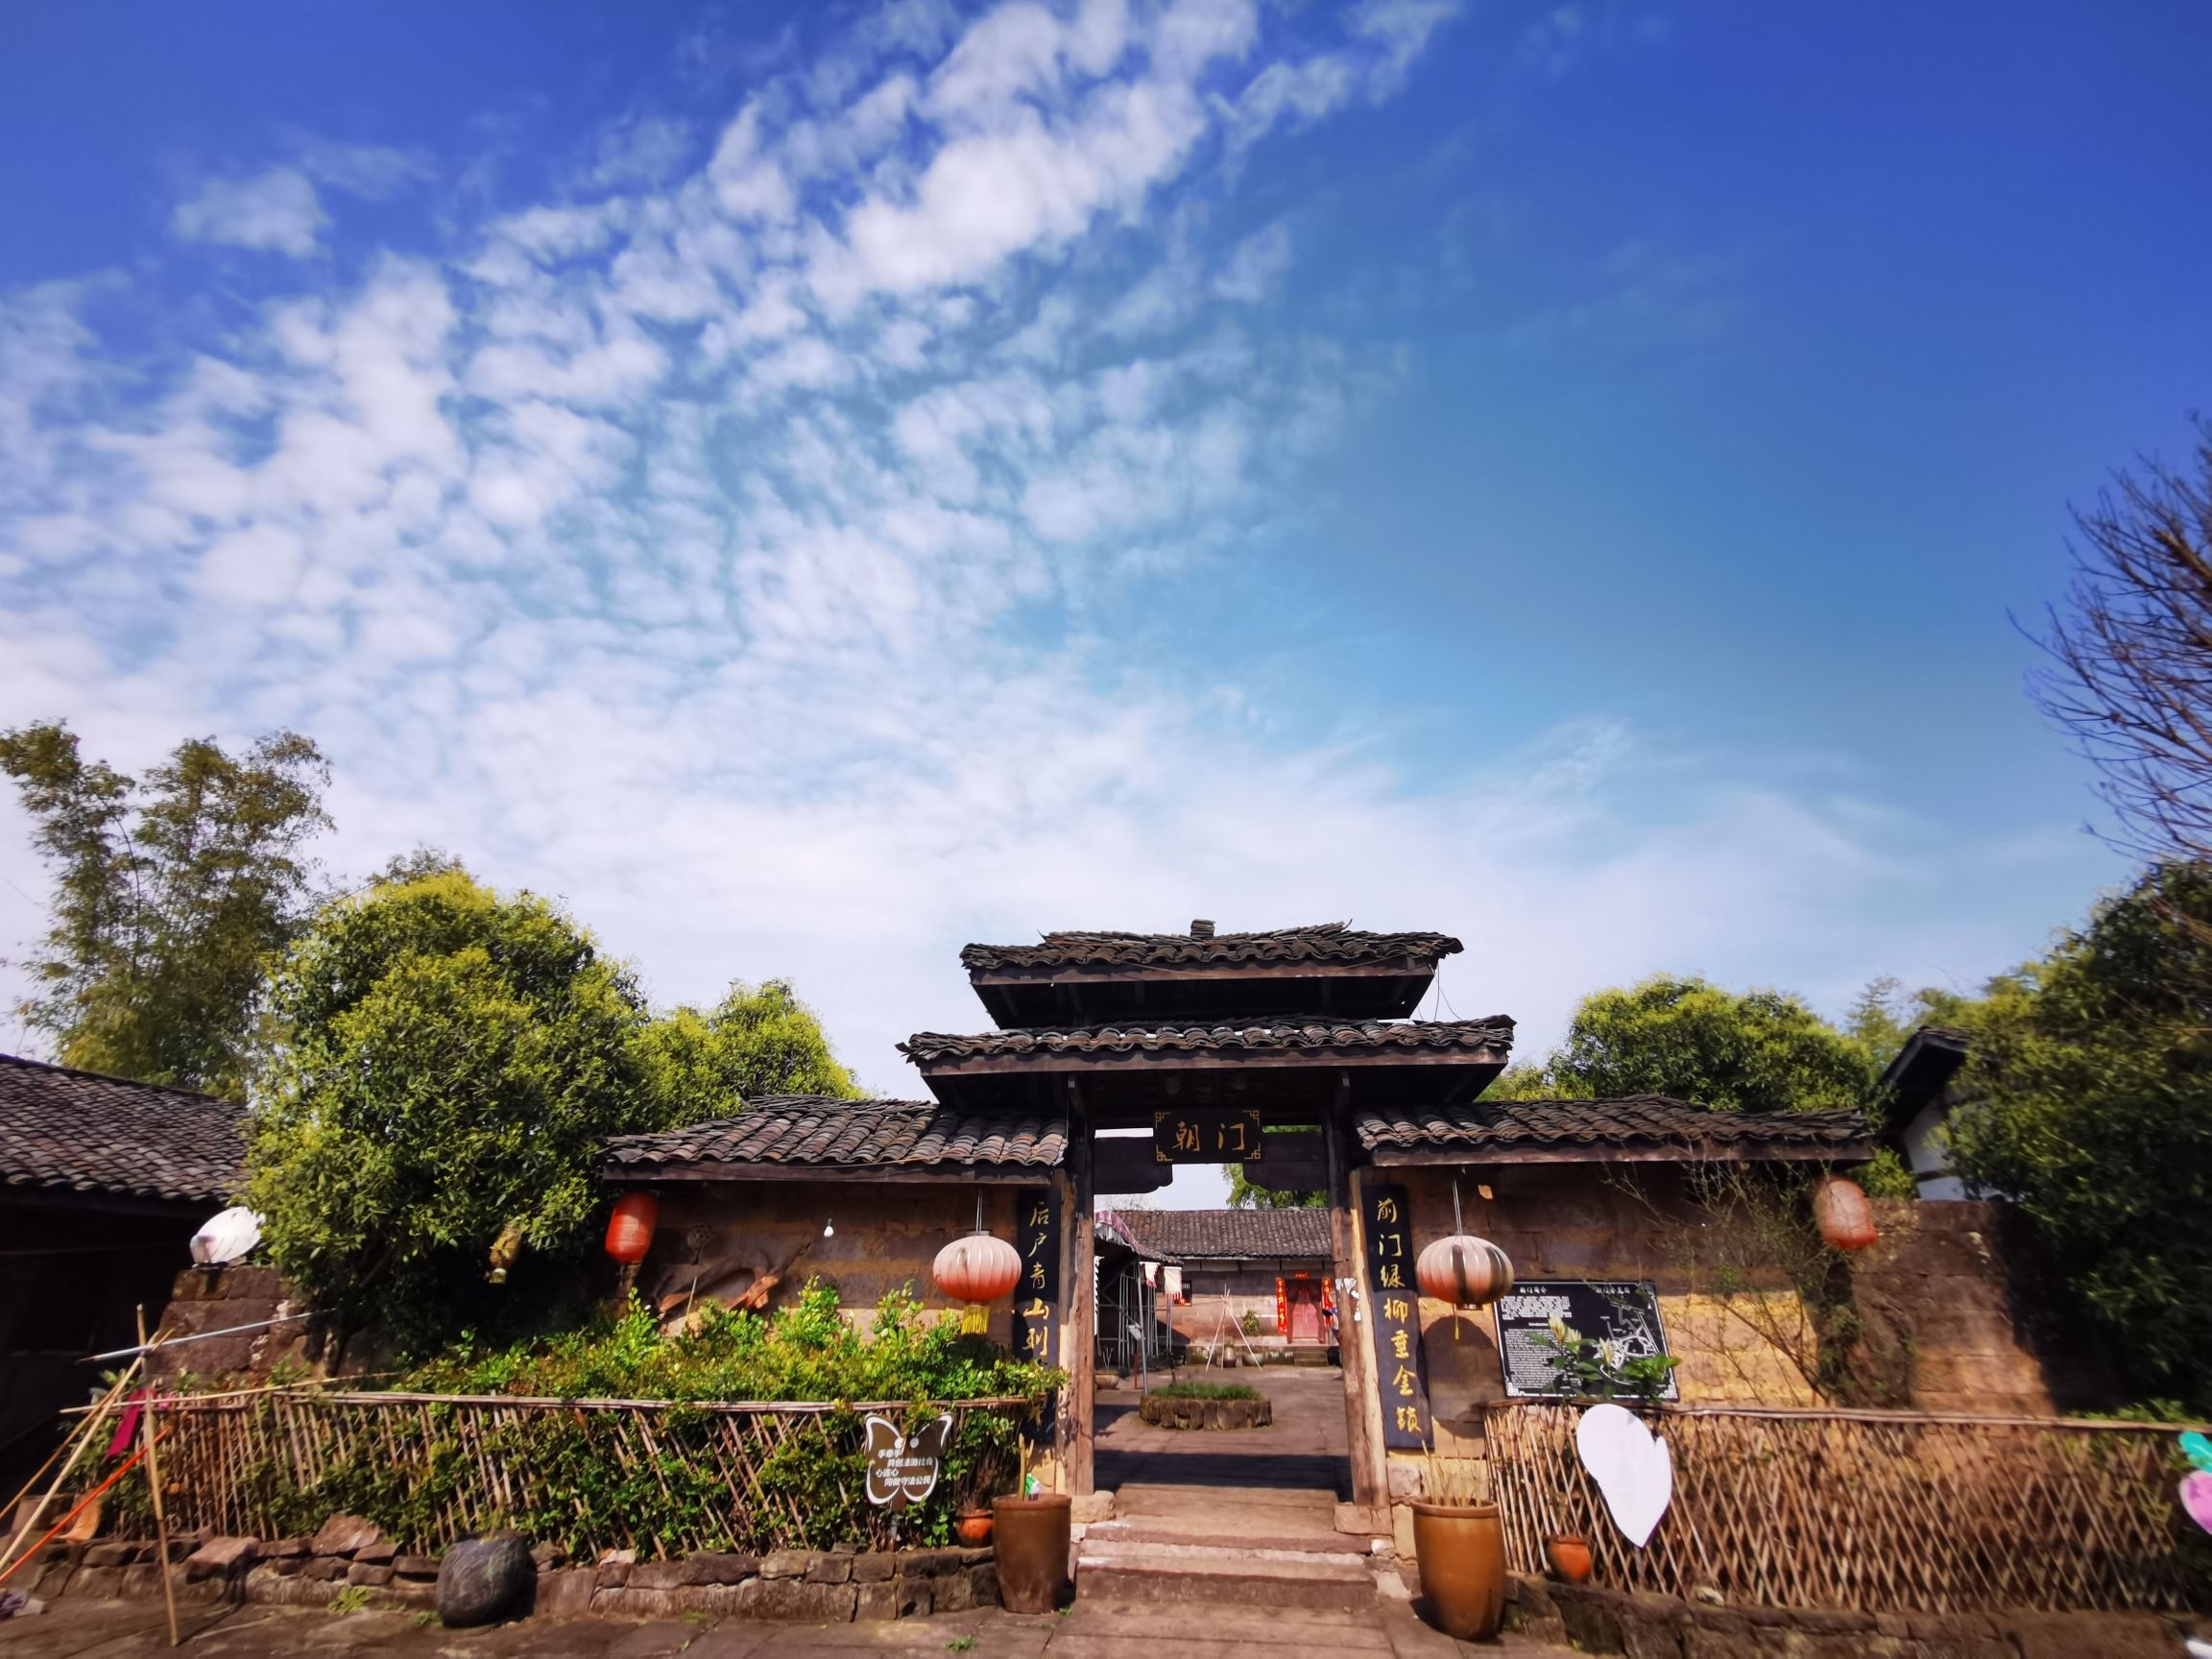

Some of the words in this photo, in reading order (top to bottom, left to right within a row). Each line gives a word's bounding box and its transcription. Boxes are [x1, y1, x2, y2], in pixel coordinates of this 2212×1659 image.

[1171, 1120, 1245, 1152] 朝门
[1022, 1201, 1050, 1429] 后户青山列
[877, 1449, 902, 1458] 手牵手
[887, 1456, 933, 1468] 共创法治社会
[875, 1468, 899, 1478] 心连心
